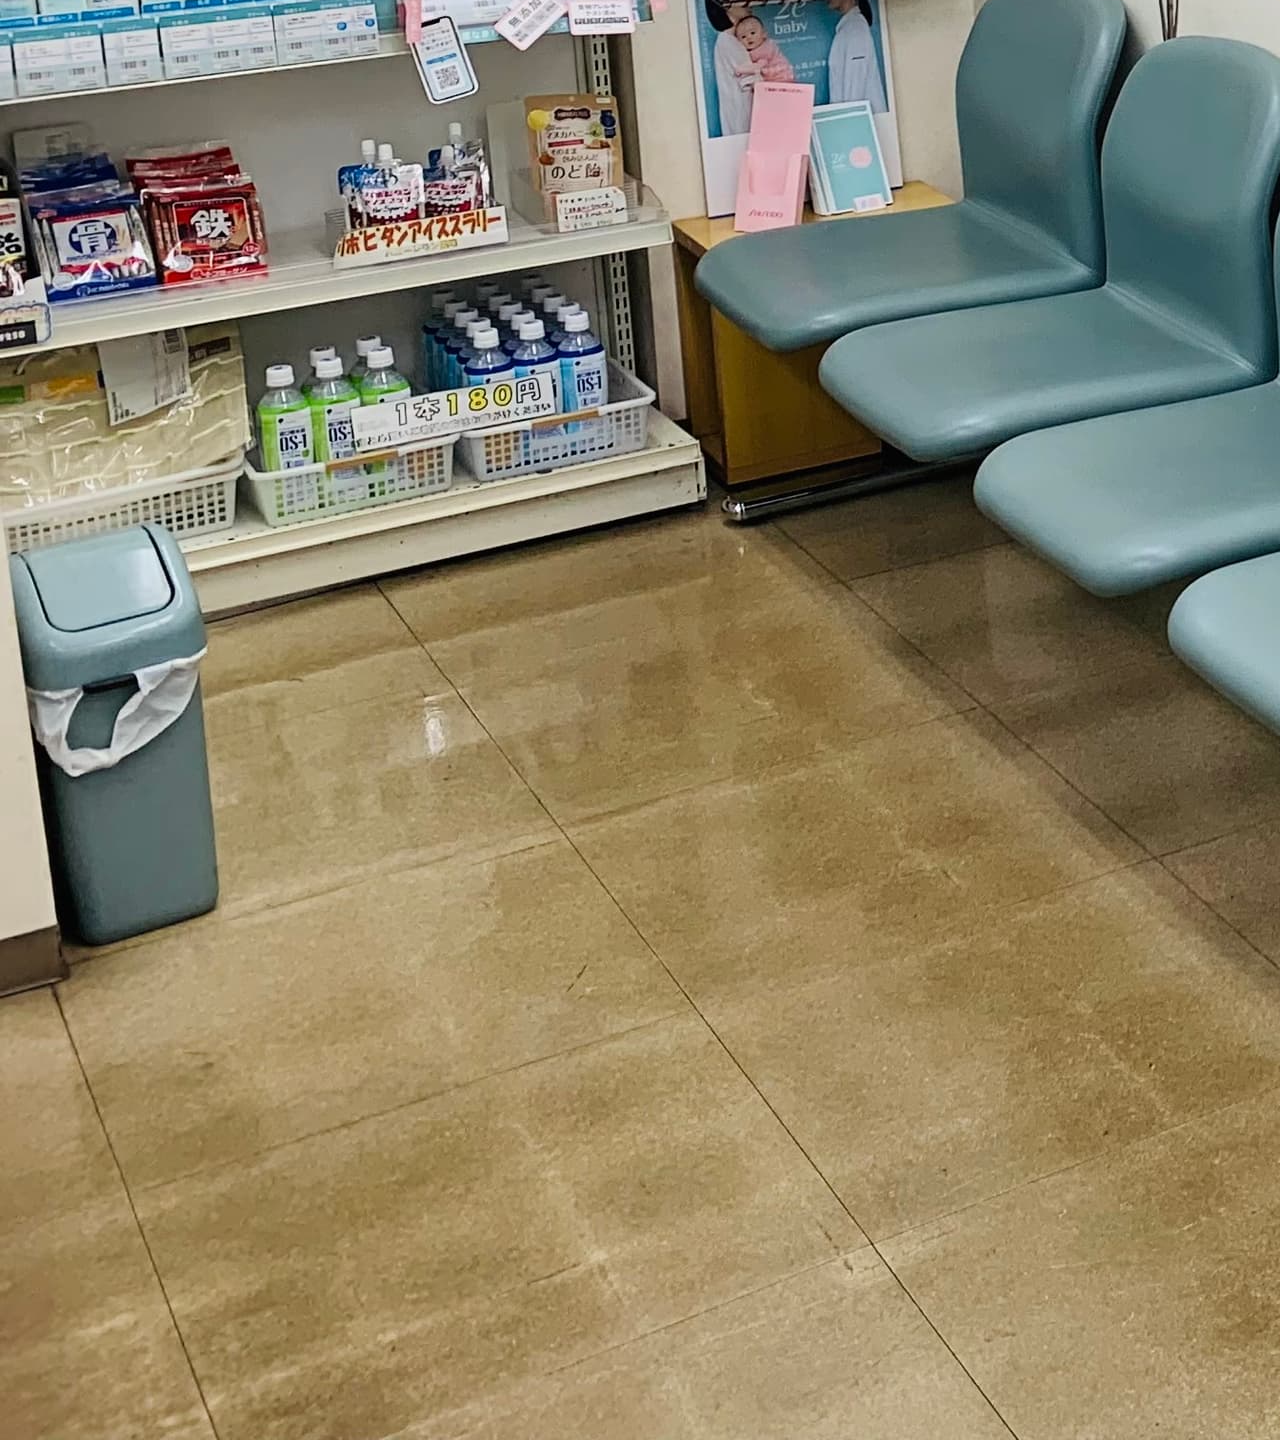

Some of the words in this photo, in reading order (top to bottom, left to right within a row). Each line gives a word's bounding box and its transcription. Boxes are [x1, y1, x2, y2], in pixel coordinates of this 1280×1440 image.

[774, 20, 808, 35] baby
[551, 163, 602, 179] のど飴
[190, 209, 232, 238] 鉄
[71, 223, 112, 255] 骨
[577, 376, 602, 392] OS-1
[395, 378, 542, 426] 1本180円
[280, 433, 307, 452] OS-1
[329, 423, 354, 443] OS-1
